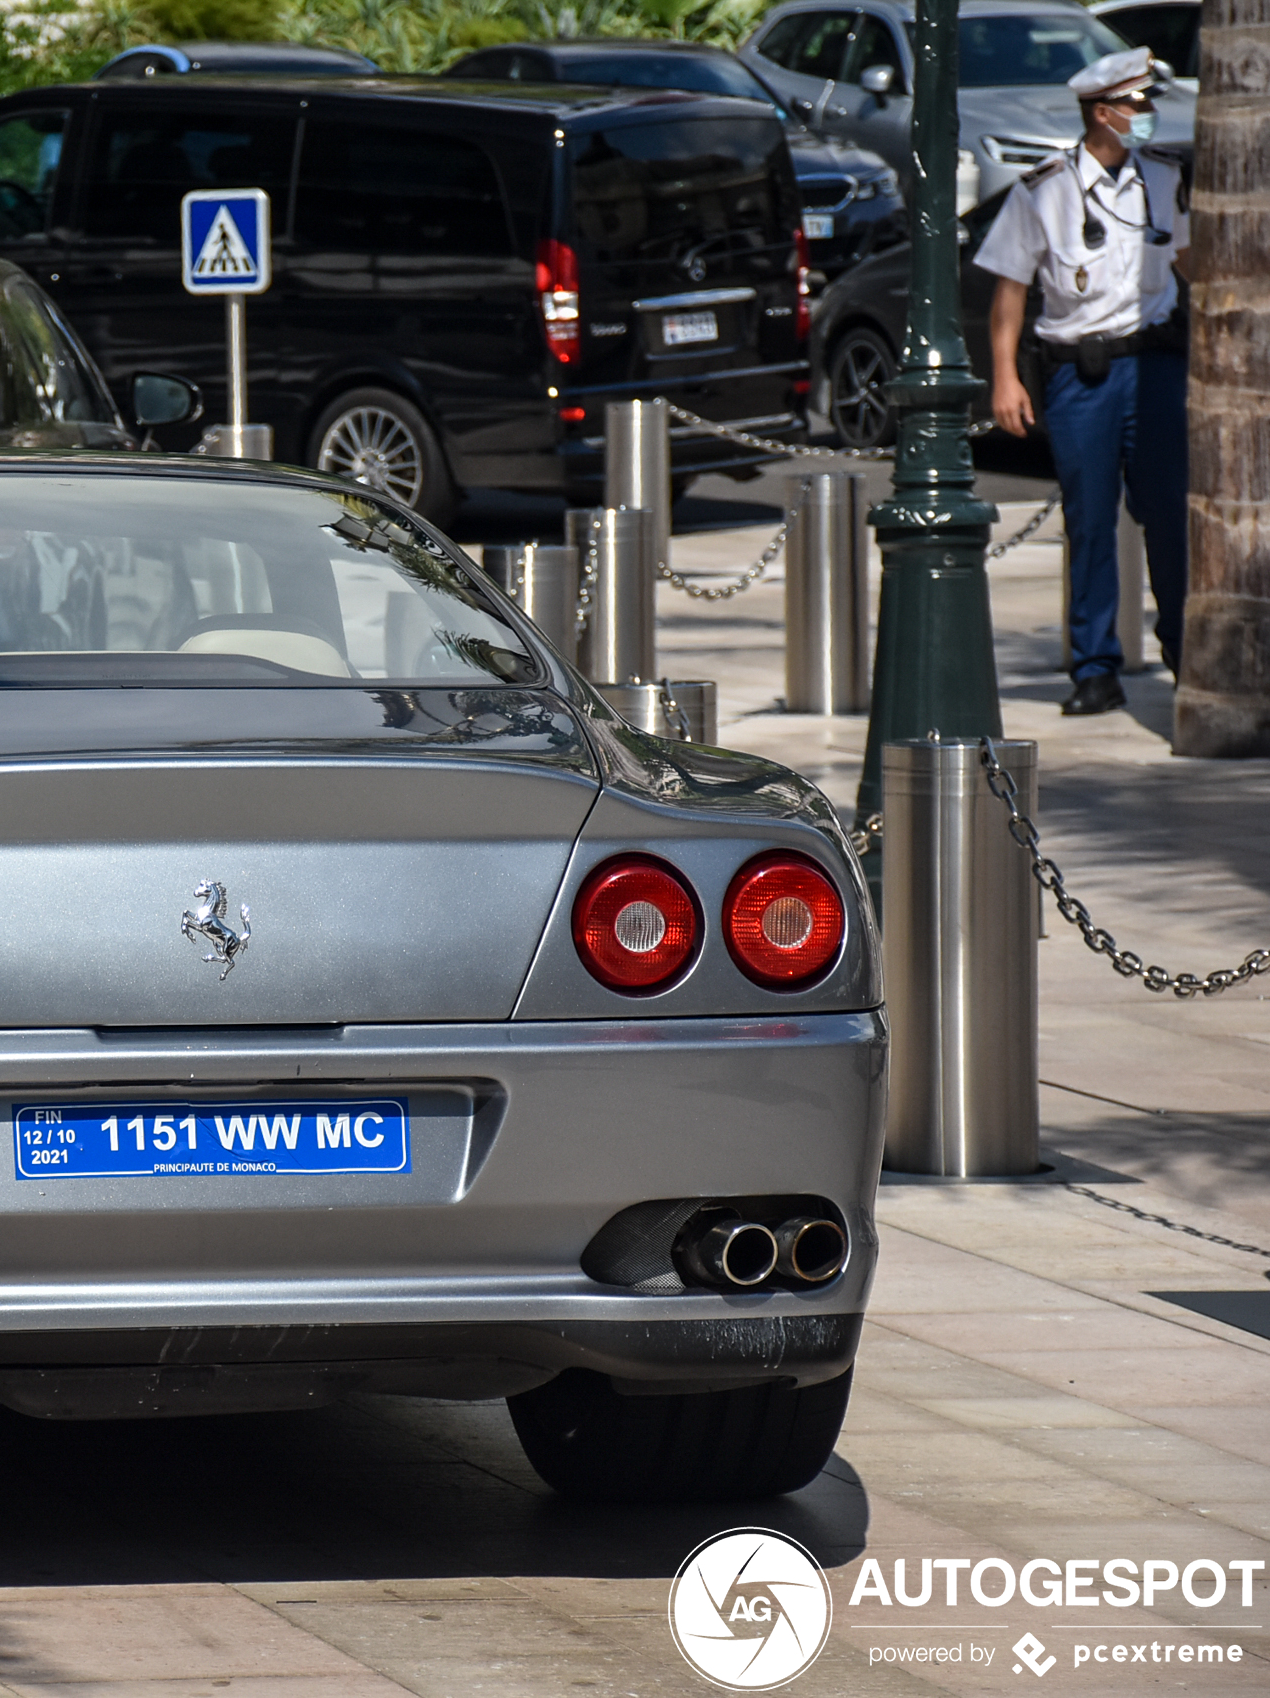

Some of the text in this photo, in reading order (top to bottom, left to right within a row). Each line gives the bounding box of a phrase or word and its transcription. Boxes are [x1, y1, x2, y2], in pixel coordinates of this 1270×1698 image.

[34, 1110, 62, 1125] FIN
[23, 1130, 43, 1145] 12
[56, 1129, 76, 1144] 10
[101, 1111, 385, 1151] 1151 WW MC
[30, 1149, 68, 1165] 2021
[153, 1162, 276, 1173] PRINCIPAUTE DE MONACO
